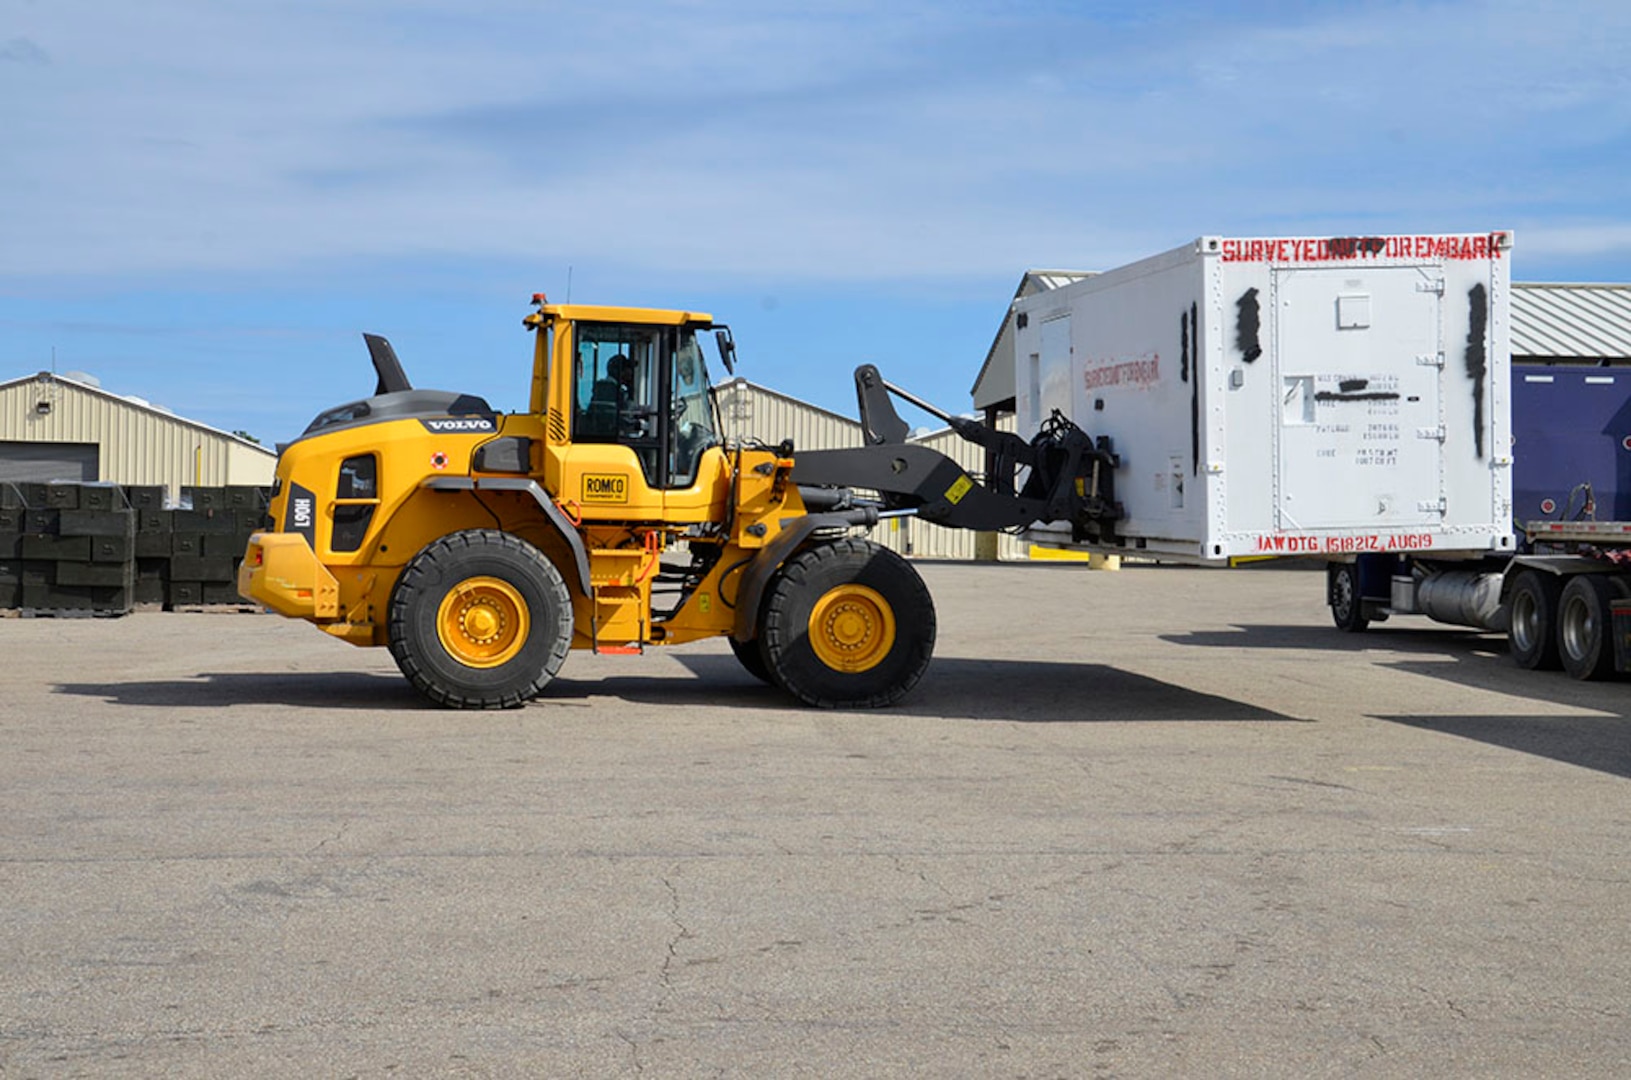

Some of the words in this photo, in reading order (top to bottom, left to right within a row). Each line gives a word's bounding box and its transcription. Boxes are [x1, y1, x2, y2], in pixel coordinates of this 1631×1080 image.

[1221, 238, 1330, 262] SURVEYED
[428, 420, 492, 430] VOLVO
[586, 478, 624, 493] ROMCO
[294, 498, 311, 527] L90H
[1288, 536, 1318, 551] DTG
